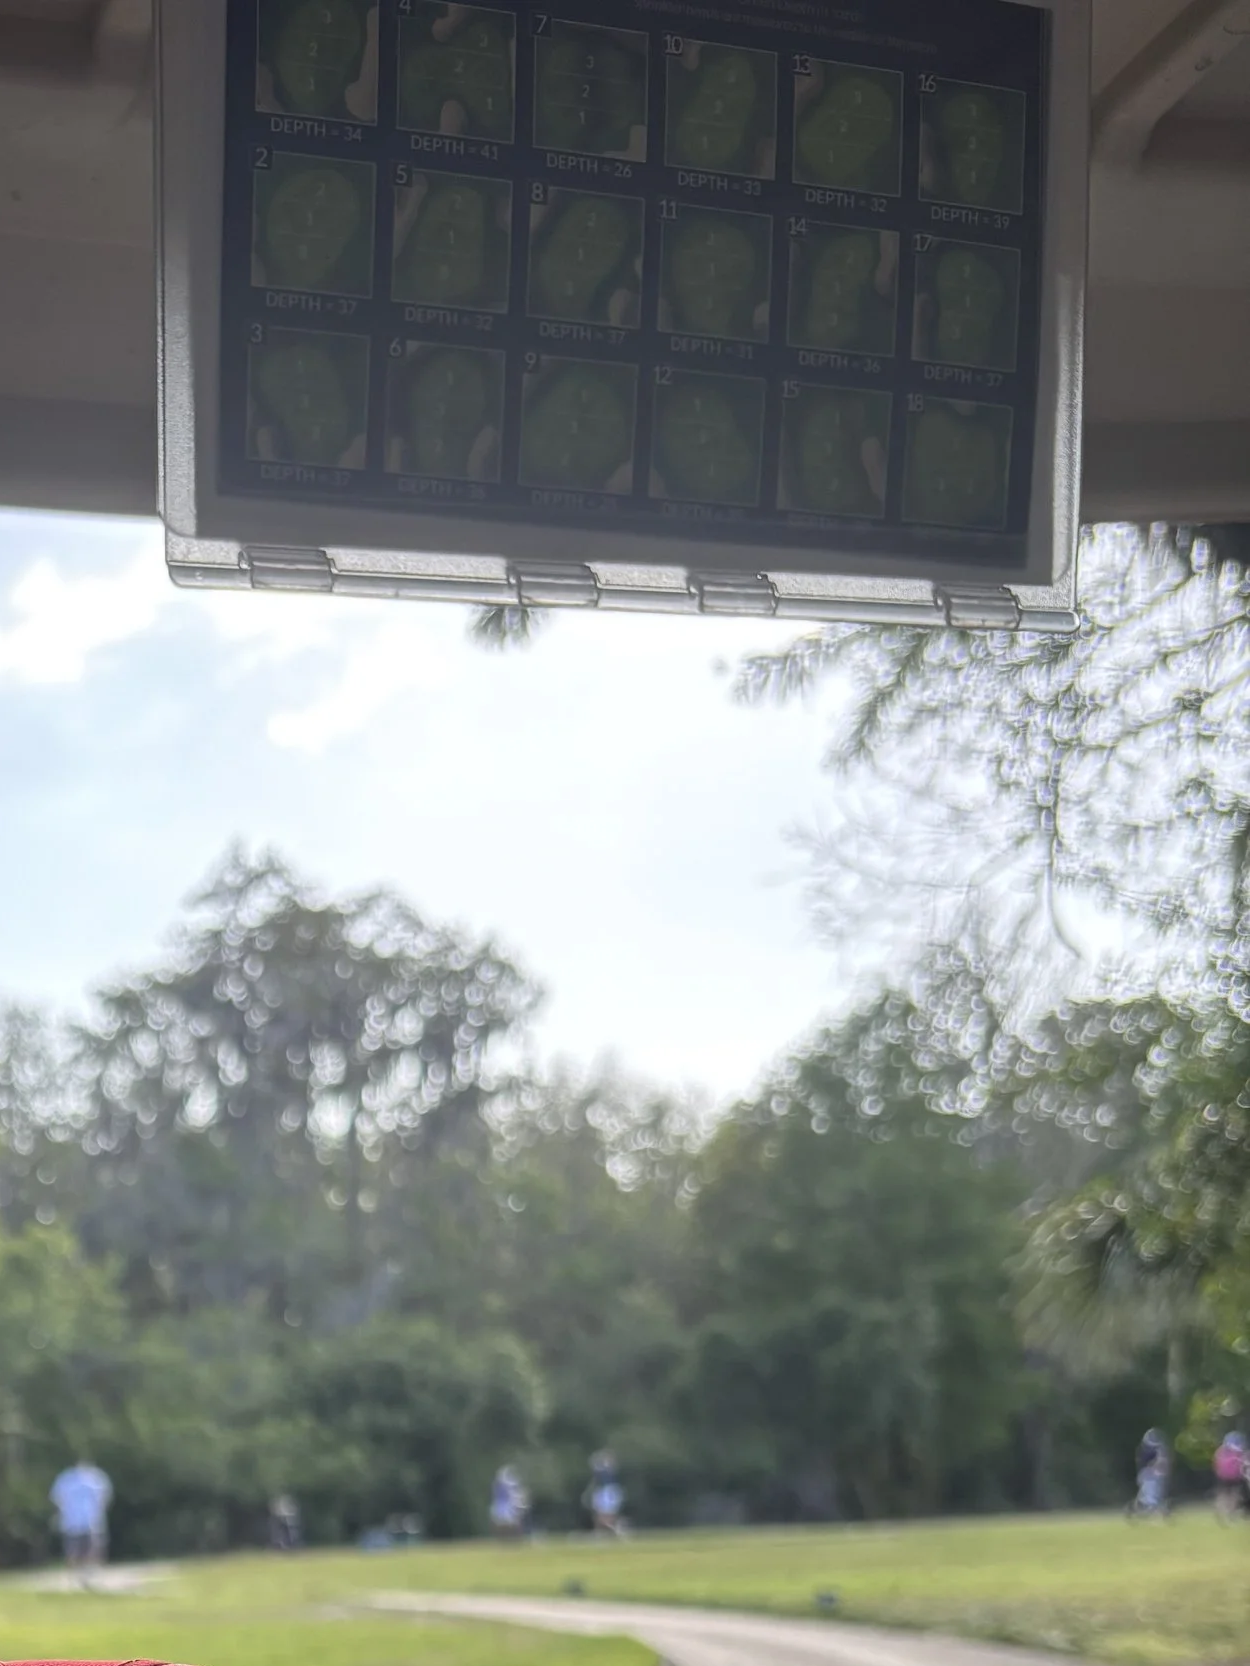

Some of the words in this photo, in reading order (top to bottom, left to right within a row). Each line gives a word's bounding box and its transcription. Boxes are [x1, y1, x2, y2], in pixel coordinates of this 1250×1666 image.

[535, 15, 547, 33] 7
[665, 35, 683, 53] 10
[793, 56, 810, 74] 13
[919, 75, 936, 93] 16
[270, 118, 326, 137] DEPTH
[344, 127, 362, 142] 34
[255, 148, 268, 167] 2
[411, 136, 464, 155] DEPTH
[480, 145, 499, 161] 41
[396, 165, 407, 183] 5
[546, 154, 598, 173] DEPTH
[615, 163, 632, 177] 26
[531, 183, 543, 200] 8
[678, 171, 728, 190] DEPTH
[744, 181, 761, 195] 33
[660, 200, 678, 219] 11
[805, 190, 854, 208] DEPTH
[871, 198, 887, 212] 32
[788, 218, 806, 235] 14
[931, 206, 978, 224] DEPTH
[994, 216, 1009, 229] 39
[915, 235, 933, 251] 17
[266, 291, 321, 311] DEPTH
[405, 307, 458, 325] DEPTH
[251, 324, 262, 343] 3
[540, 322, 592, 341] DEPTH
[390, 338, 402, 357] 6
[671, 337, 721, 355] DEPTH
[525, 352, 536, 370] 9
[798, 351, 848, 368] DEPTH
[654, 366, 672, 384] 12
[924, 365, 972, 383] DEPTH
[782, 380, 798, 398] 15
